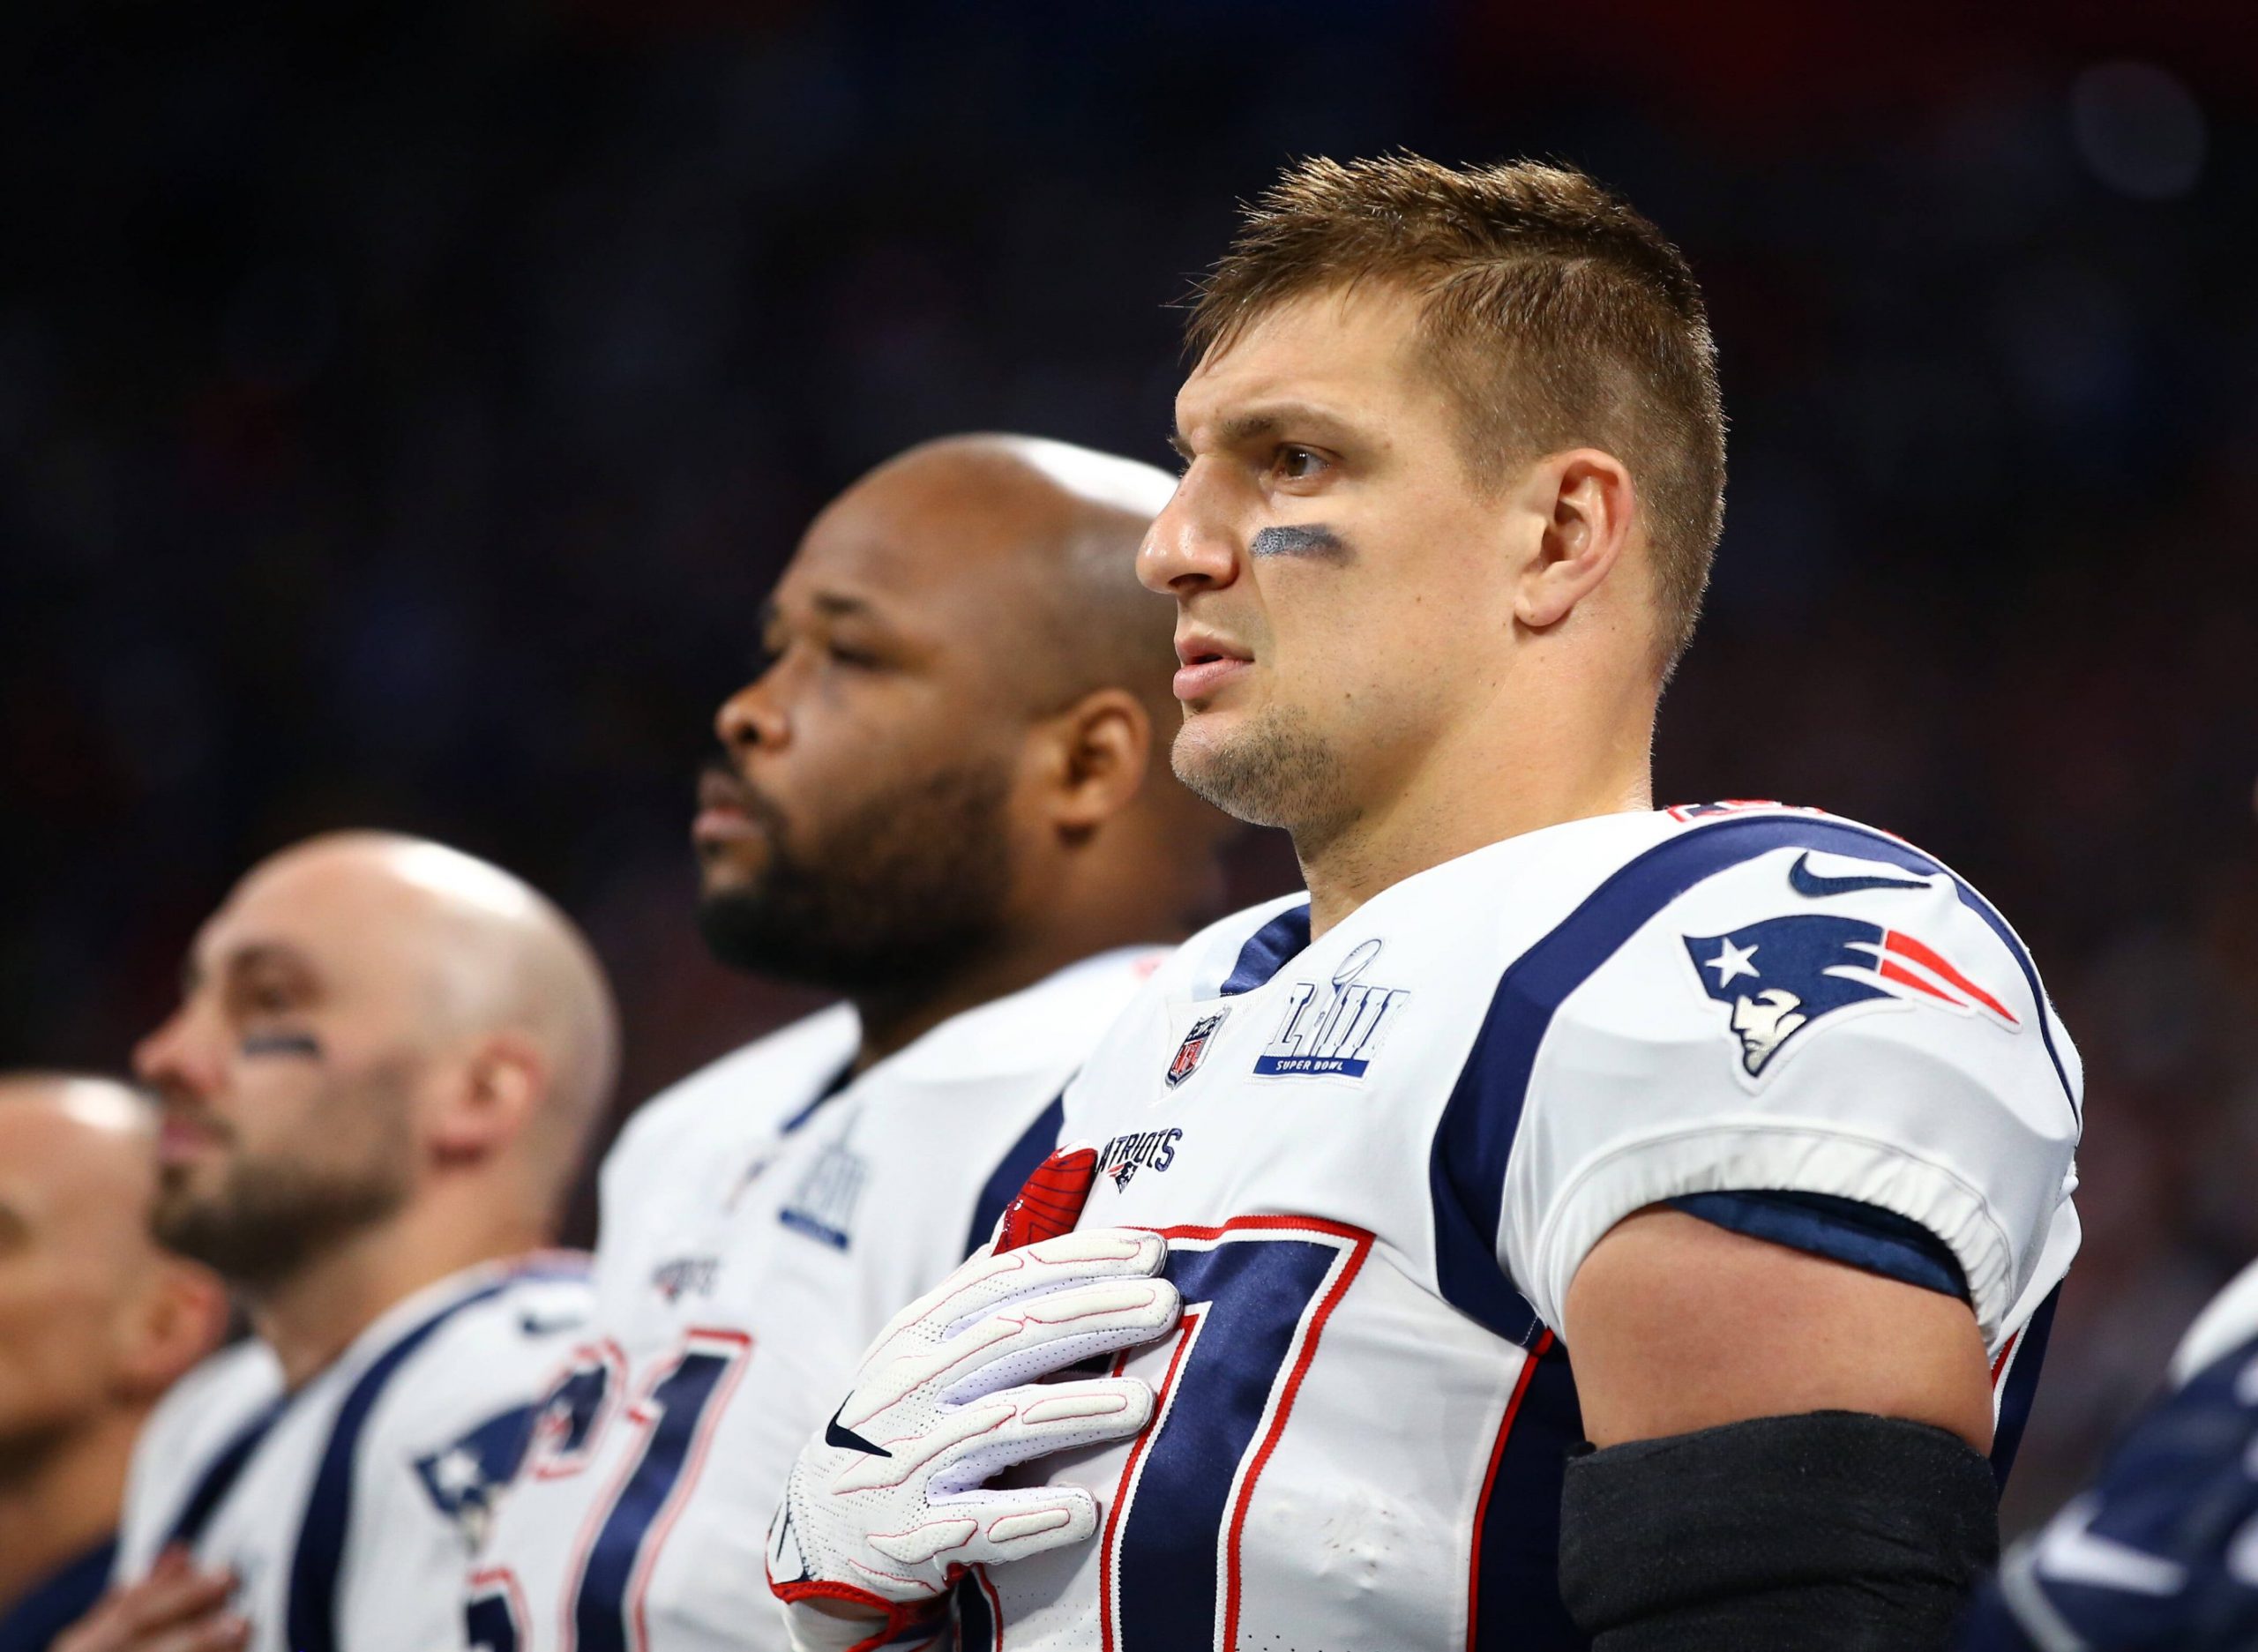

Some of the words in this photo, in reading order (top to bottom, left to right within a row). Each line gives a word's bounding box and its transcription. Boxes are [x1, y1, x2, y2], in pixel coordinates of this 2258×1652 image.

[1275, 1059, 1312, 1071] SUPER
[1313, 1060, 1344, 1071] BOWL
[1095, 1128, 1183, 1173] ATRIOTS
[960, 1215, 1377, 1652] 7
